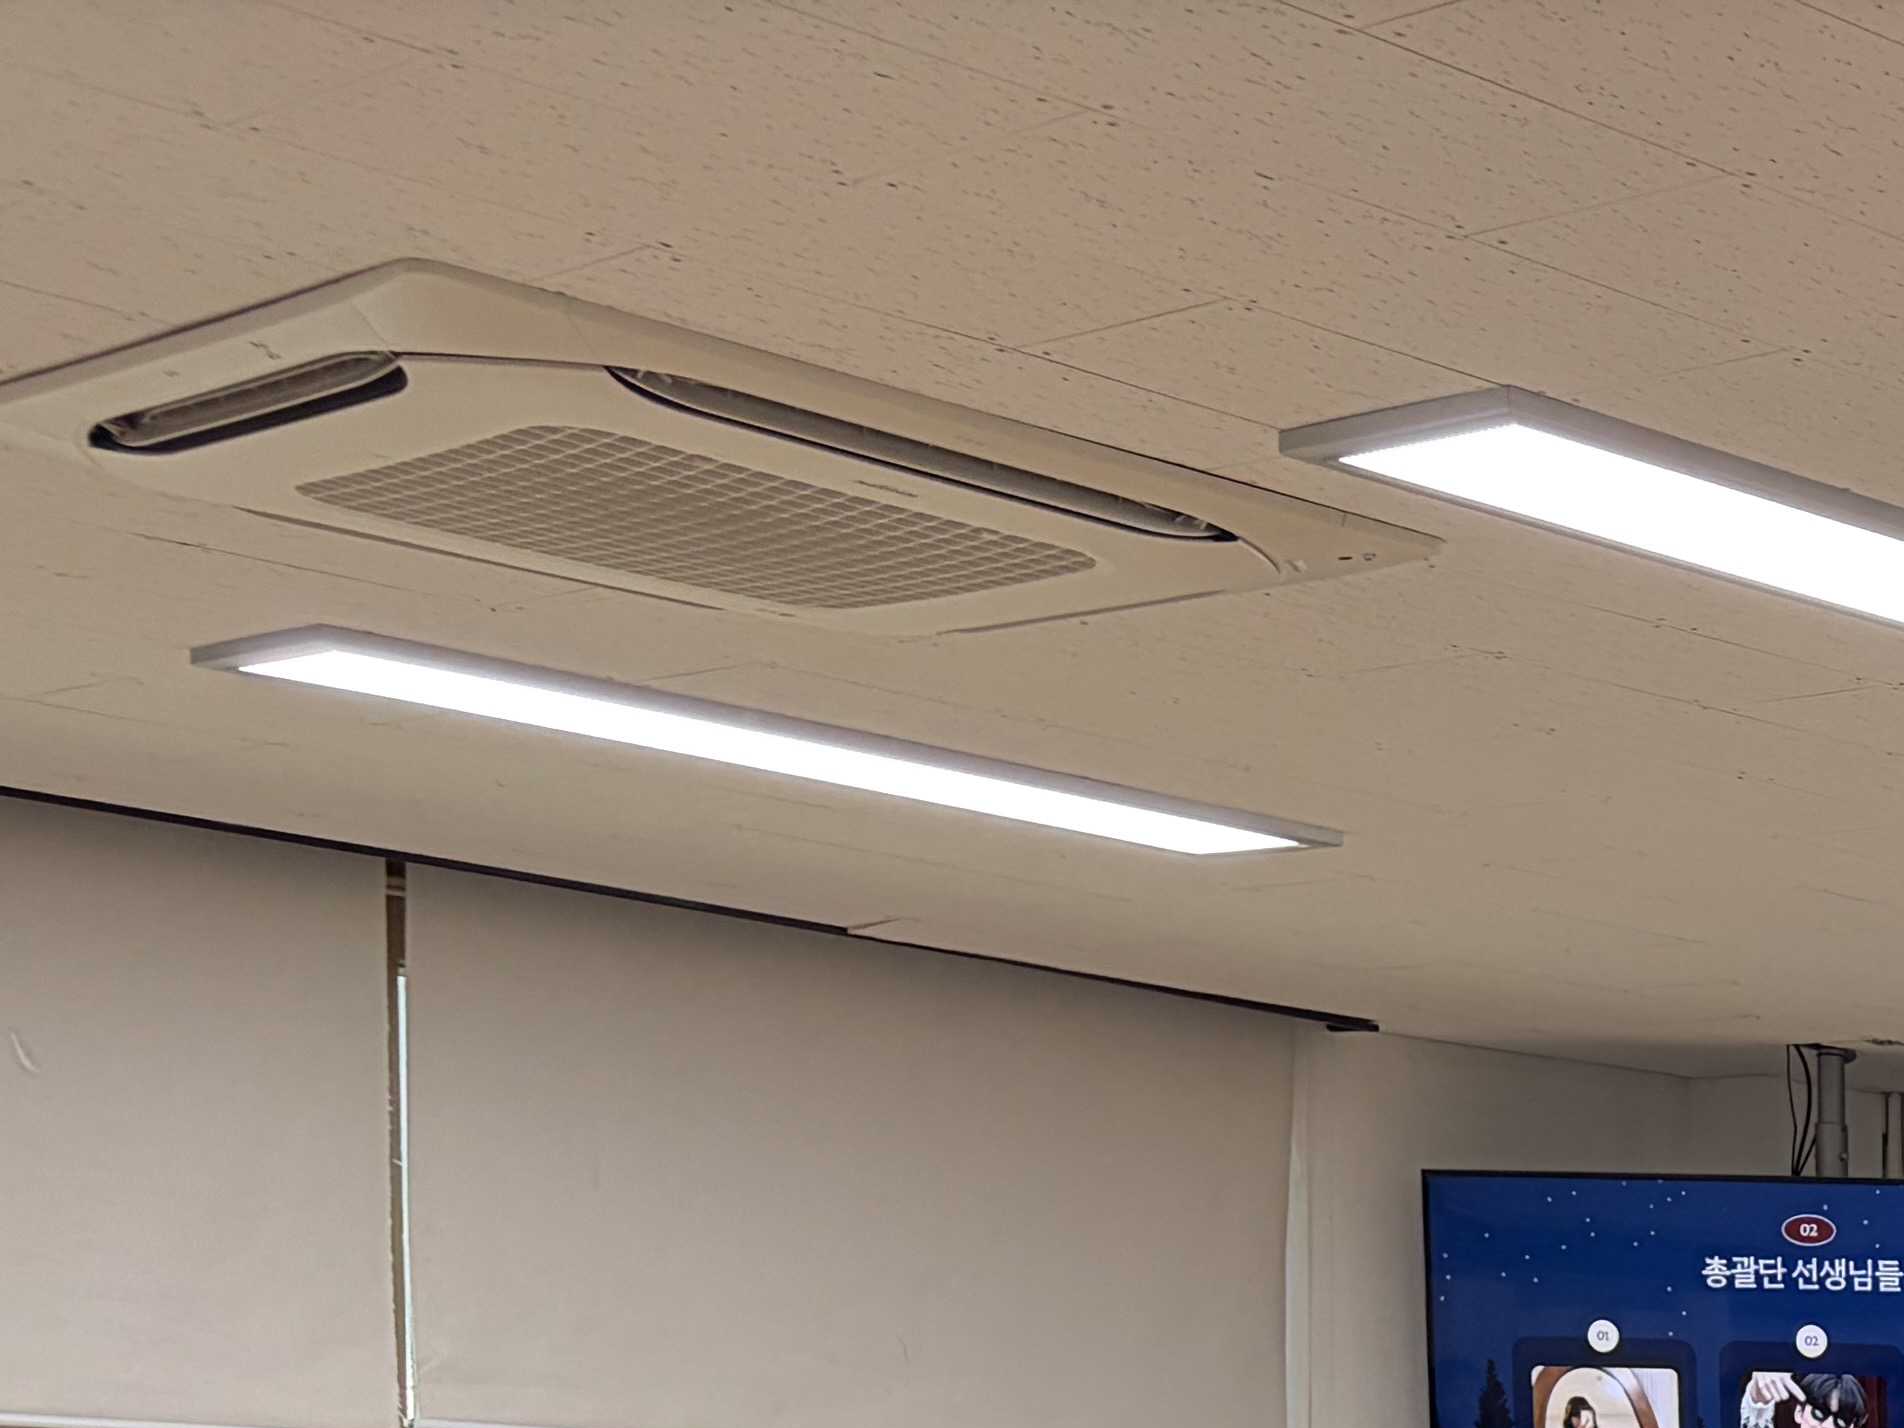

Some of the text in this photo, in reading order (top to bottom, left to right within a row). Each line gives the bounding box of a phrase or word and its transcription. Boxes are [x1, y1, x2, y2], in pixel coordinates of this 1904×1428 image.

[1799, 1223, 1819, 1237] 02
[1701, 1256, 1788, 1290] 총괄단
[1596, 1330, 1609, 1341] 01
[1804, 1335, 1820, 1347] 02
